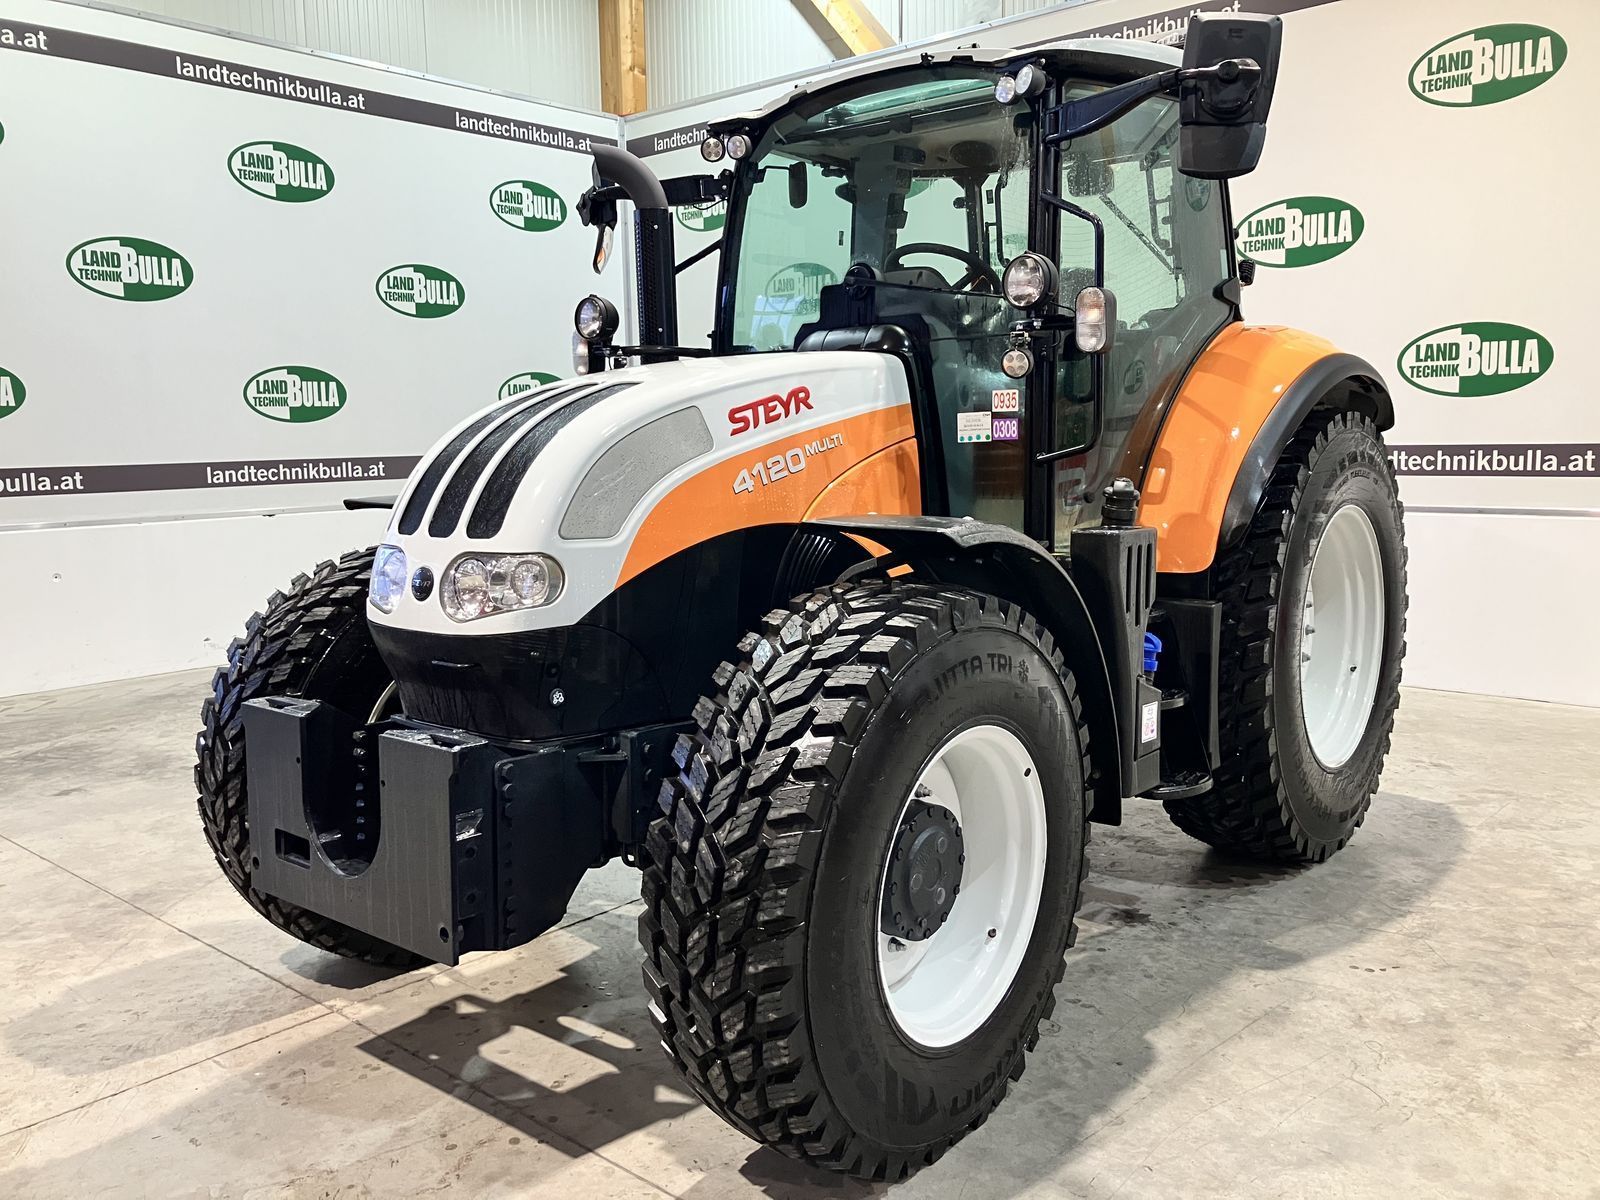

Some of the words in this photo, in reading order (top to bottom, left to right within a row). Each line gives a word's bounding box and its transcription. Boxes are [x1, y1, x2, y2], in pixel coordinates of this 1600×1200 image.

[1427, 49, 1473, 76] LAND
[1472, 36, 1554, 85] BULLA
[175, 55, 366, 110] landtechnikbulla.at
[1420, 72, 1473, 94] TECHNIK
[455, 111, 592, 152] landtechnikbulla.at
[240, 151, 274, 171] LAND
[273, 149, 328, 191] BULLA
[237, 168, 275, 184] TECHNIK
[499, 189, 523, 206] LAND
[522, 187, 562, 222] BULLA
[496, 203, 524, 217] TECHNIK
[1247, 217, 1286, 238] LAND
[1285, 208, 1353, 250] BULLA
[1242, 236, 1286, 253] TECHNIK
[81, 249, 121, 268] LAND
[120, 245, 185, 287] BULLA
[78, 267, 123, 283] TECHNIK
[386, 275, 414, 291] LAND
[384, 290, 415, 303] TECHNIK
[413, 272, 459, 306] BULLA
[1415, 342, 1460, 363] LAND
[1459, 333, 1540, 377] BULLA
[1409, 363, 1460, 379] TECHNIK
[256, 379, 288, 395] LAND
[286, 374, 340, 407] BULLA
[253, 396, 289, 407] TECHNIK
[727, 385, 814, 437] STEYR
[993, 392, 1017, 410] 0935
[992, 420, 1018, 438] 0308
[206, 460, 386, 484] landtechnikbulla.at
[732, 447, 806, 495] 4120
[804, 432, 844, 458] MULTI
